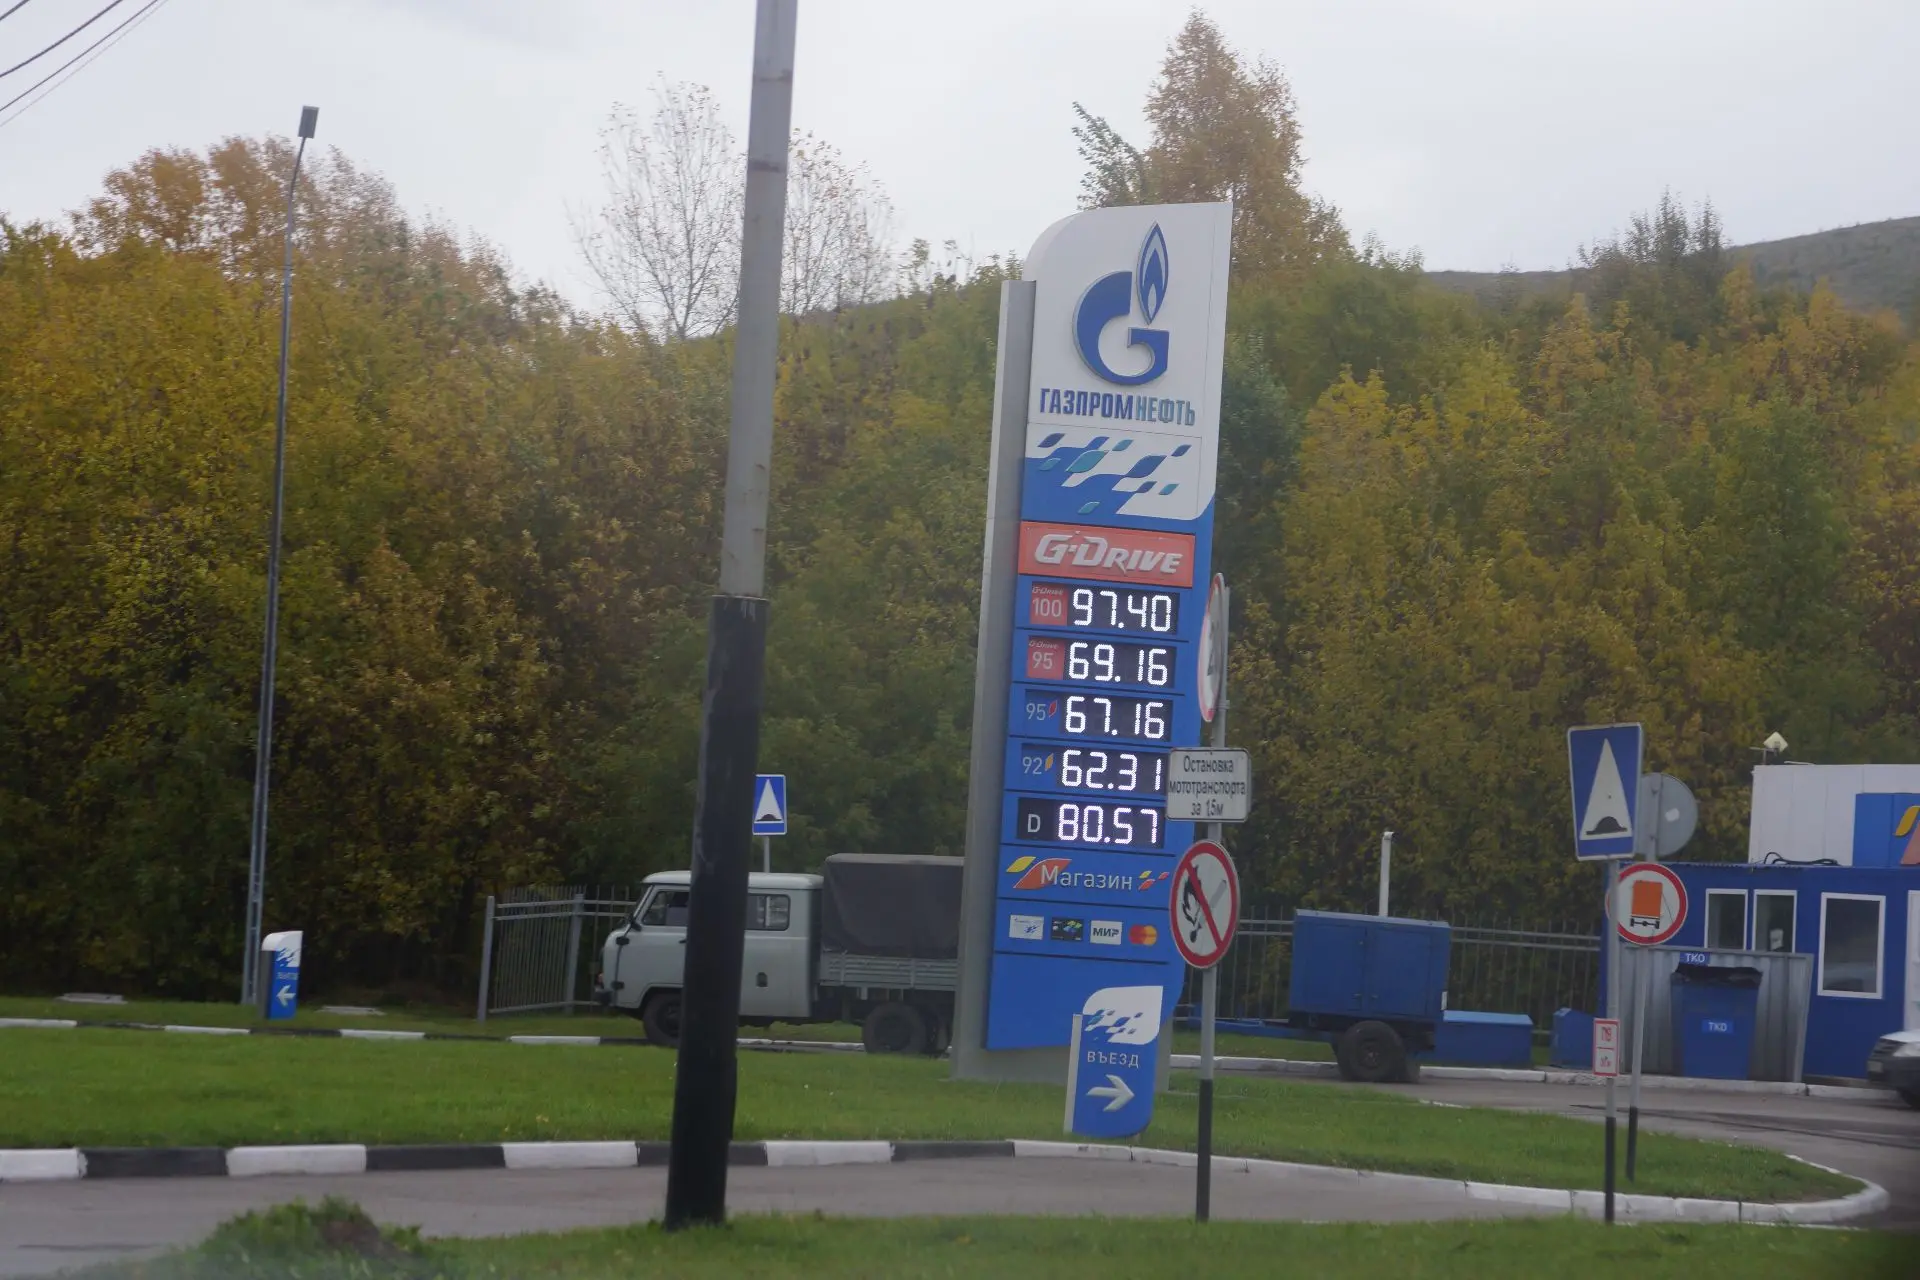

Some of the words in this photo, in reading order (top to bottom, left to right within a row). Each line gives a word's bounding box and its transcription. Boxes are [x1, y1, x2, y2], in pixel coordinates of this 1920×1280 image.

[1032, 597, 1062, 617] 100
[1073, 588, 1171, 632] 97.40
[1031, 651, 1054, 670] 95
[1026, 703, 1046, 721] 95
[1022, 756, 1042, 775] 92
[1061, 749, 1162, 791] 62.31
[1183, 755, 1234, 773] Остановка
[1169, 780, 1246, 799] мототранспорта
[1191, 802, 1202, 816] за
[1027, 813, 1041, 833] D
[1058, 803, 1158, 844] 80.57
[1040, 864, 1133, 891] Магазин
[1092, 927, 1120, 938] МИР
[1087, 1051, 1139, 1069] ВЪЕЗД
